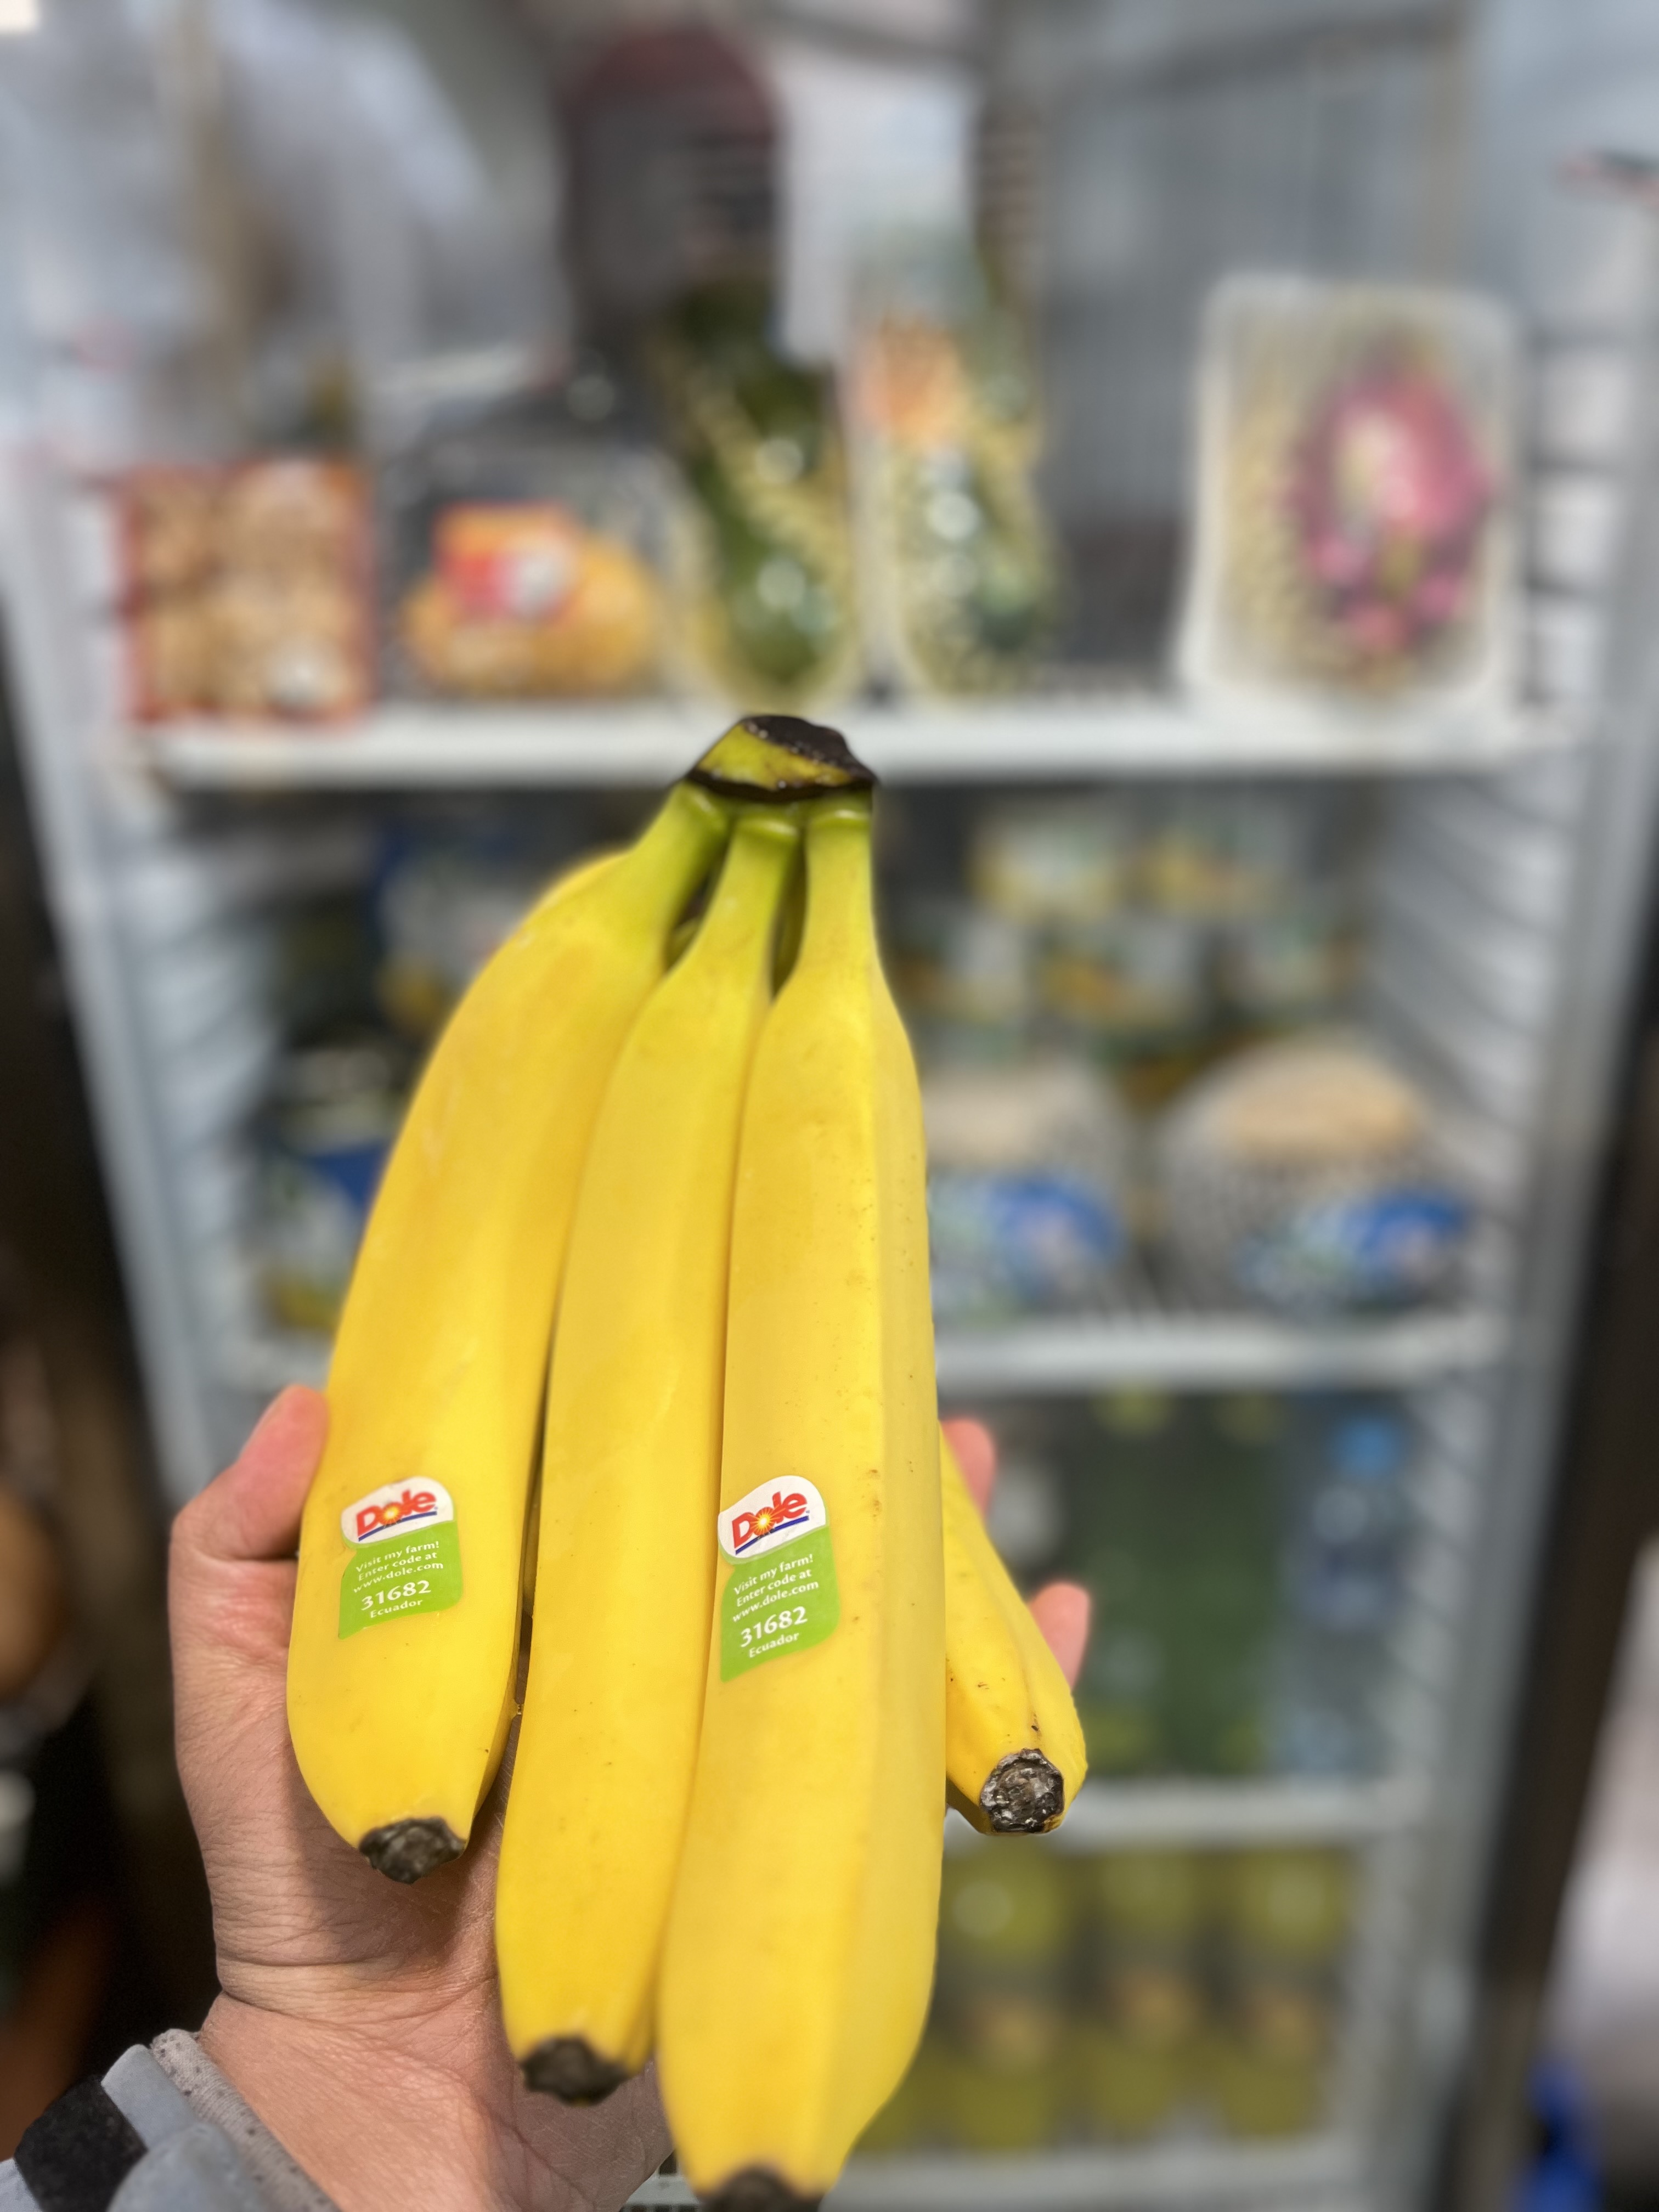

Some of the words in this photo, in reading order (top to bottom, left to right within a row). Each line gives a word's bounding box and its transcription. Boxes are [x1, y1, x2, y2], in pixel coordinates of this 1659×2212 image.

[356, 1489, 437, 1538] Dole
[732, 1491, 807, 1549] Dole
[356, 1556, 381, 1572] Visit
[385, 1550, 402, 1561] my
[405, 1541, 439, 1554] farm!
[358, 1565, 389, 1582] Enter
[393, 1555, 422, 1567] code
[353, 1562, 443, 1593] www.dole.com
[733, 1577, 757, 1596] Visit
[759, 1567, 777, 1581] my
[780, 1554, 813, 1573] farm!
[736, 1586, 766, 1607] Enter
[768, 1575, 796, 1591] code
[799, 1569, 812, 1579] at
[361, 1580, 431, 1611] 31682
[370, 1599, 423, 1618] Ecuador
[732, 1582, 819, 1623] www.dole.com
[740, 1606, 808, 1647] 31682
[749, 1631, 799, 1658] Ecuador
